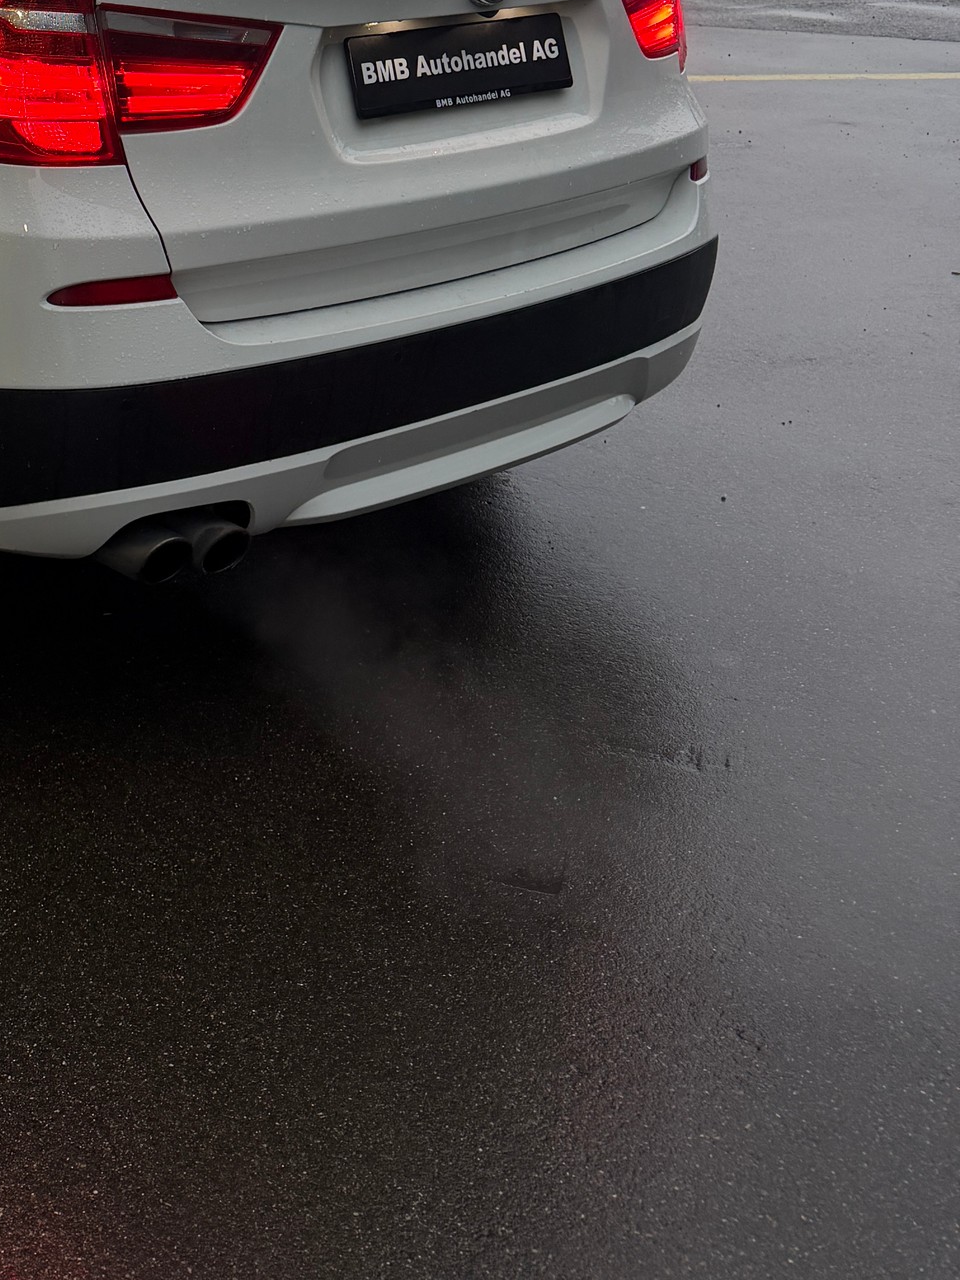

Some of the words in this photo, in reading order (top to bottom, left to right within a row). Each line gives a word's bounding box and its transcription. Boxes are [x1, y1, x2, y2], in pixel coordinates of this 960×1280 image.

[360, 57, 410, 85] BMB
[416, 42, 527, 78] Autohandel
[532, 37, 559, 61] AG
[435, 98, 453, 108] BMB
[456, 91, 499, 105] Autohandel
[500, 88, 511, 98] AG
